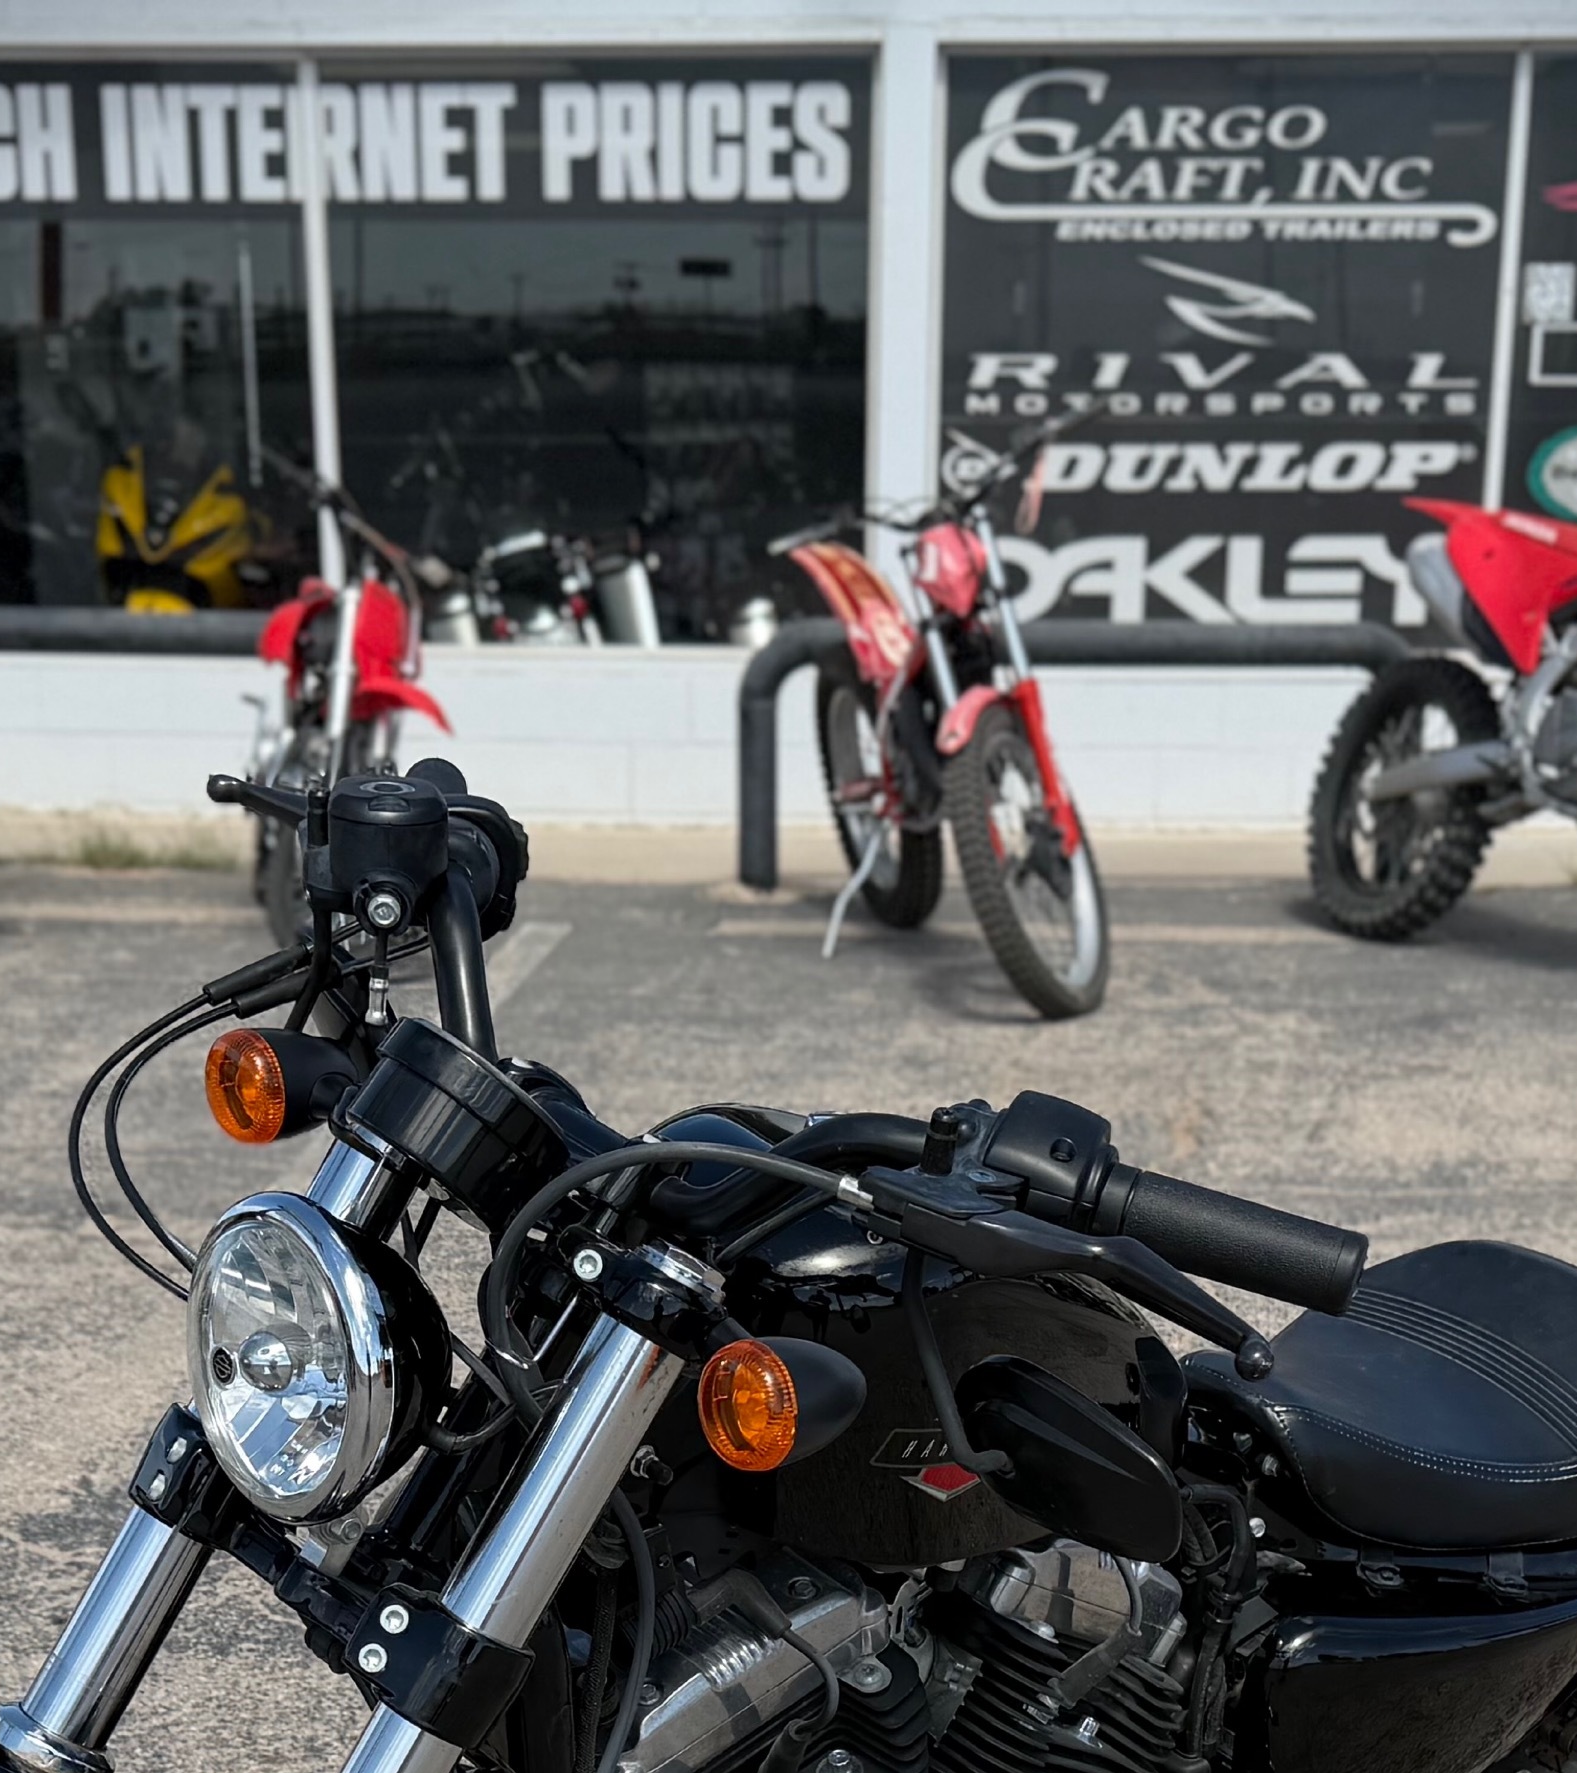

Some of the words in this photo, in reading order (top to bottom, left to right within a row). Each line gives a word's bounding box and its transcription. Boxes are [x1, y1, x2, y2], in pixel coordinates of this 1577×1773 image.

[100, 84, 517, 203] INTERNET
[540, 80, 853, 203] PRICES
[981, 68, 1328, 171] CARGO
[1294, 157, 1433, 201] INC
[1055, 218, 1253, 242] ENCLOSED
[1261, 218, 1441, 242] TRAILERS
[966, 352, 1480, 390] RIVAL
[965, 393, 1477, 416] MOTORSPORTS
[1022, 442, 1460, 493] DUNLOP
